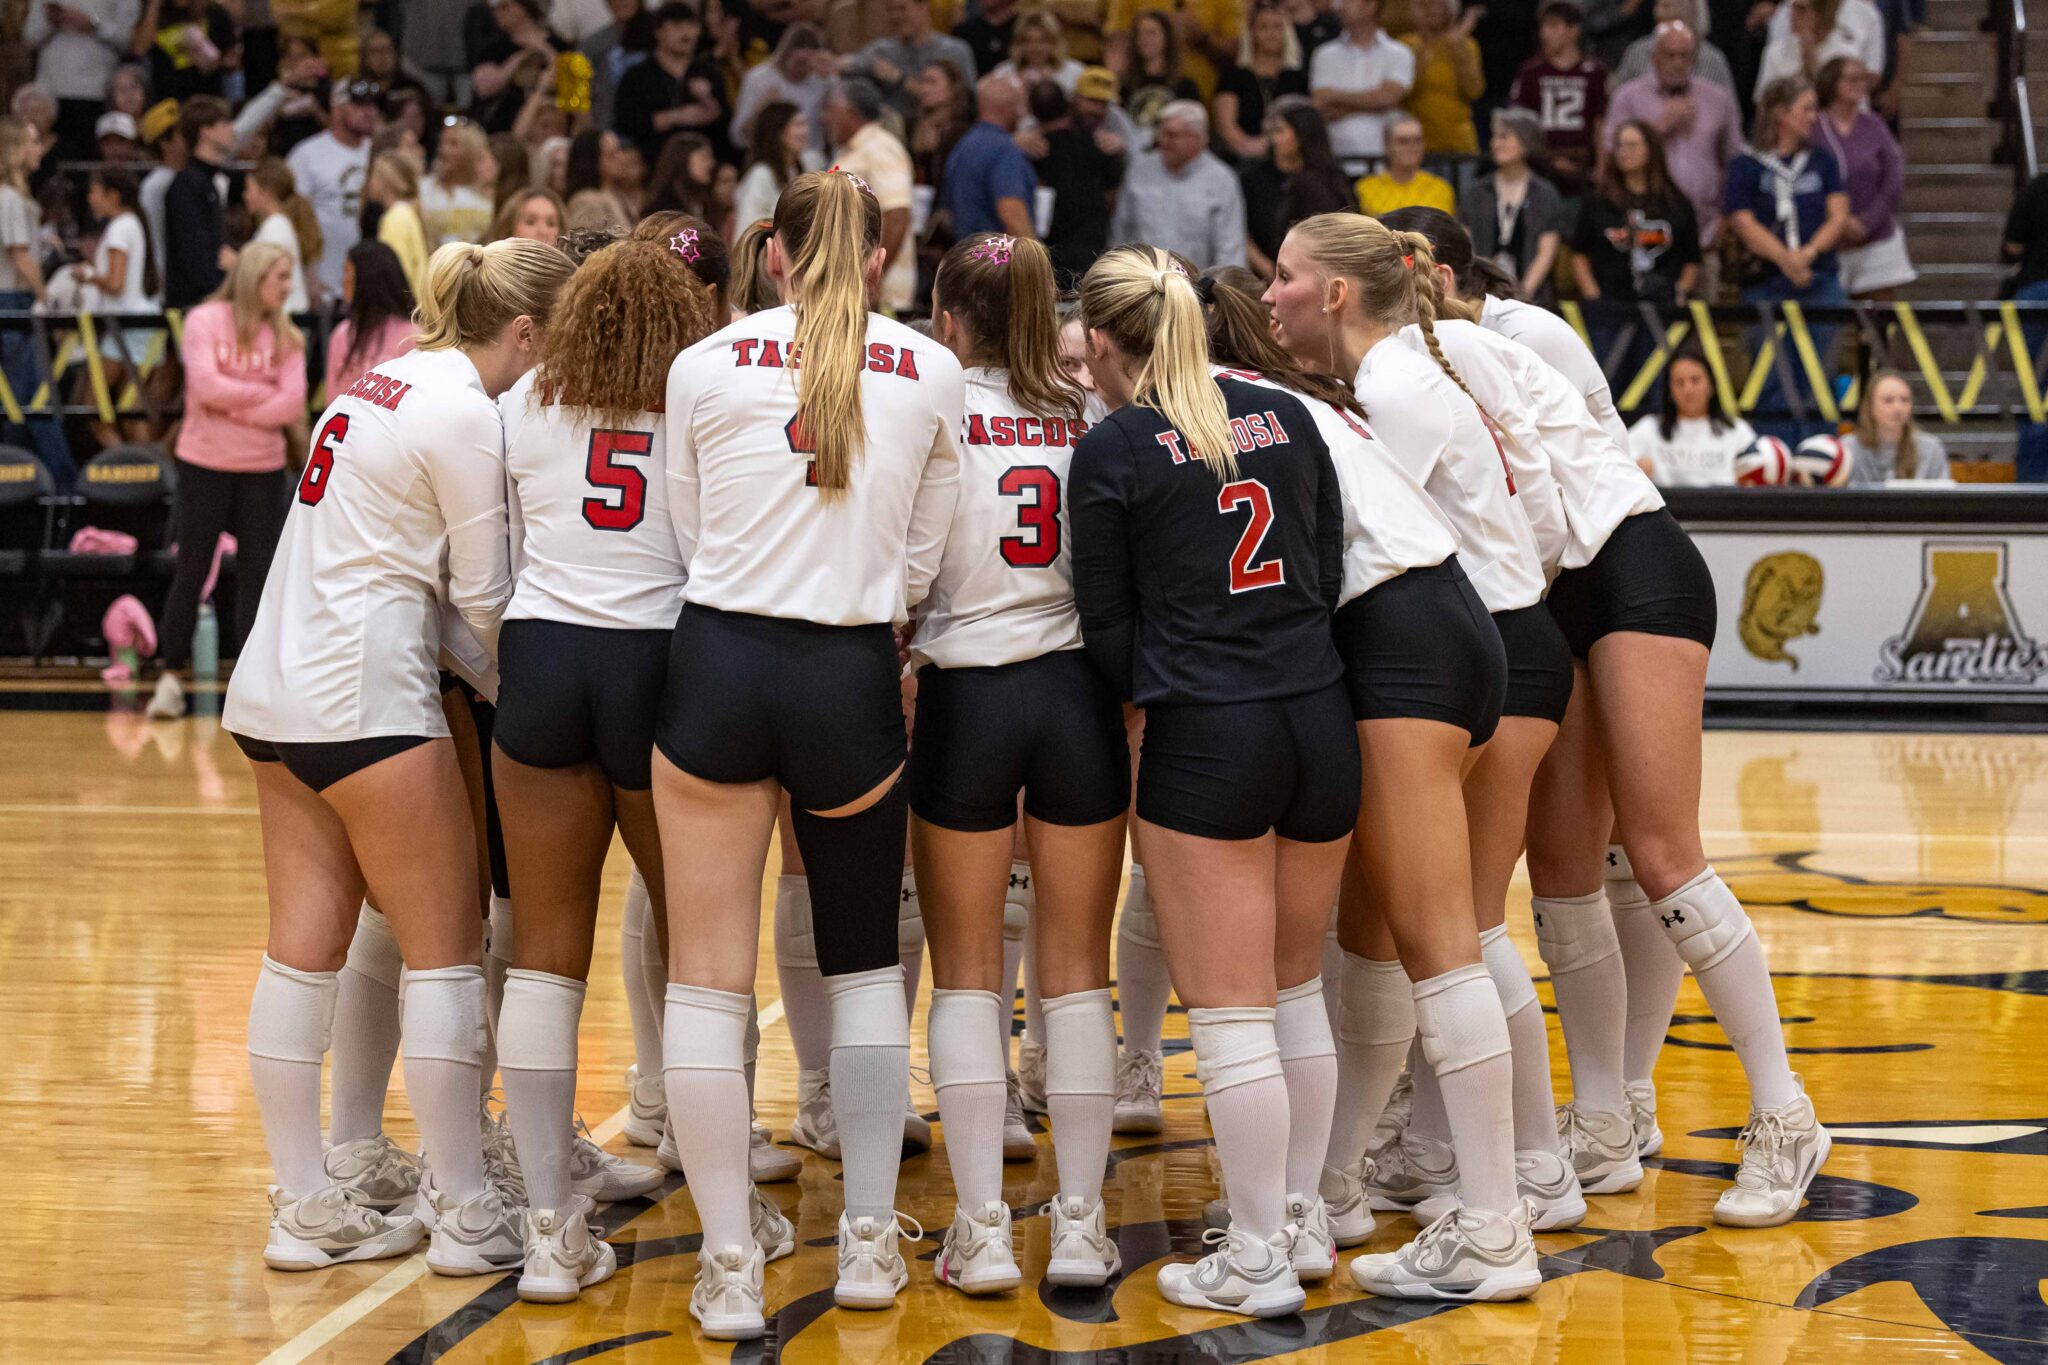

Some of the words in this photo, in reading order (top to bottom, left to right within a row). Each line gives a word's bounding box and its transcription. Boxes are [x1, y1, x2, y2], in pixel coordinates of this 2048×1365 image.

[1541, 88, 1585, 131] 12
[732, 338, 919, 381] TASSA
[960, 414, 1099, 448] ASCOS
[1155, 410, 1290, 465] TOSA
[299, 412, 350, 507] 6
[582, 428, 654, 532] 5
[998, 465, 1061, 568] 3
[1217, 478, 1286, 595] 2
[1873, 634, 2048, 684] Sandies
